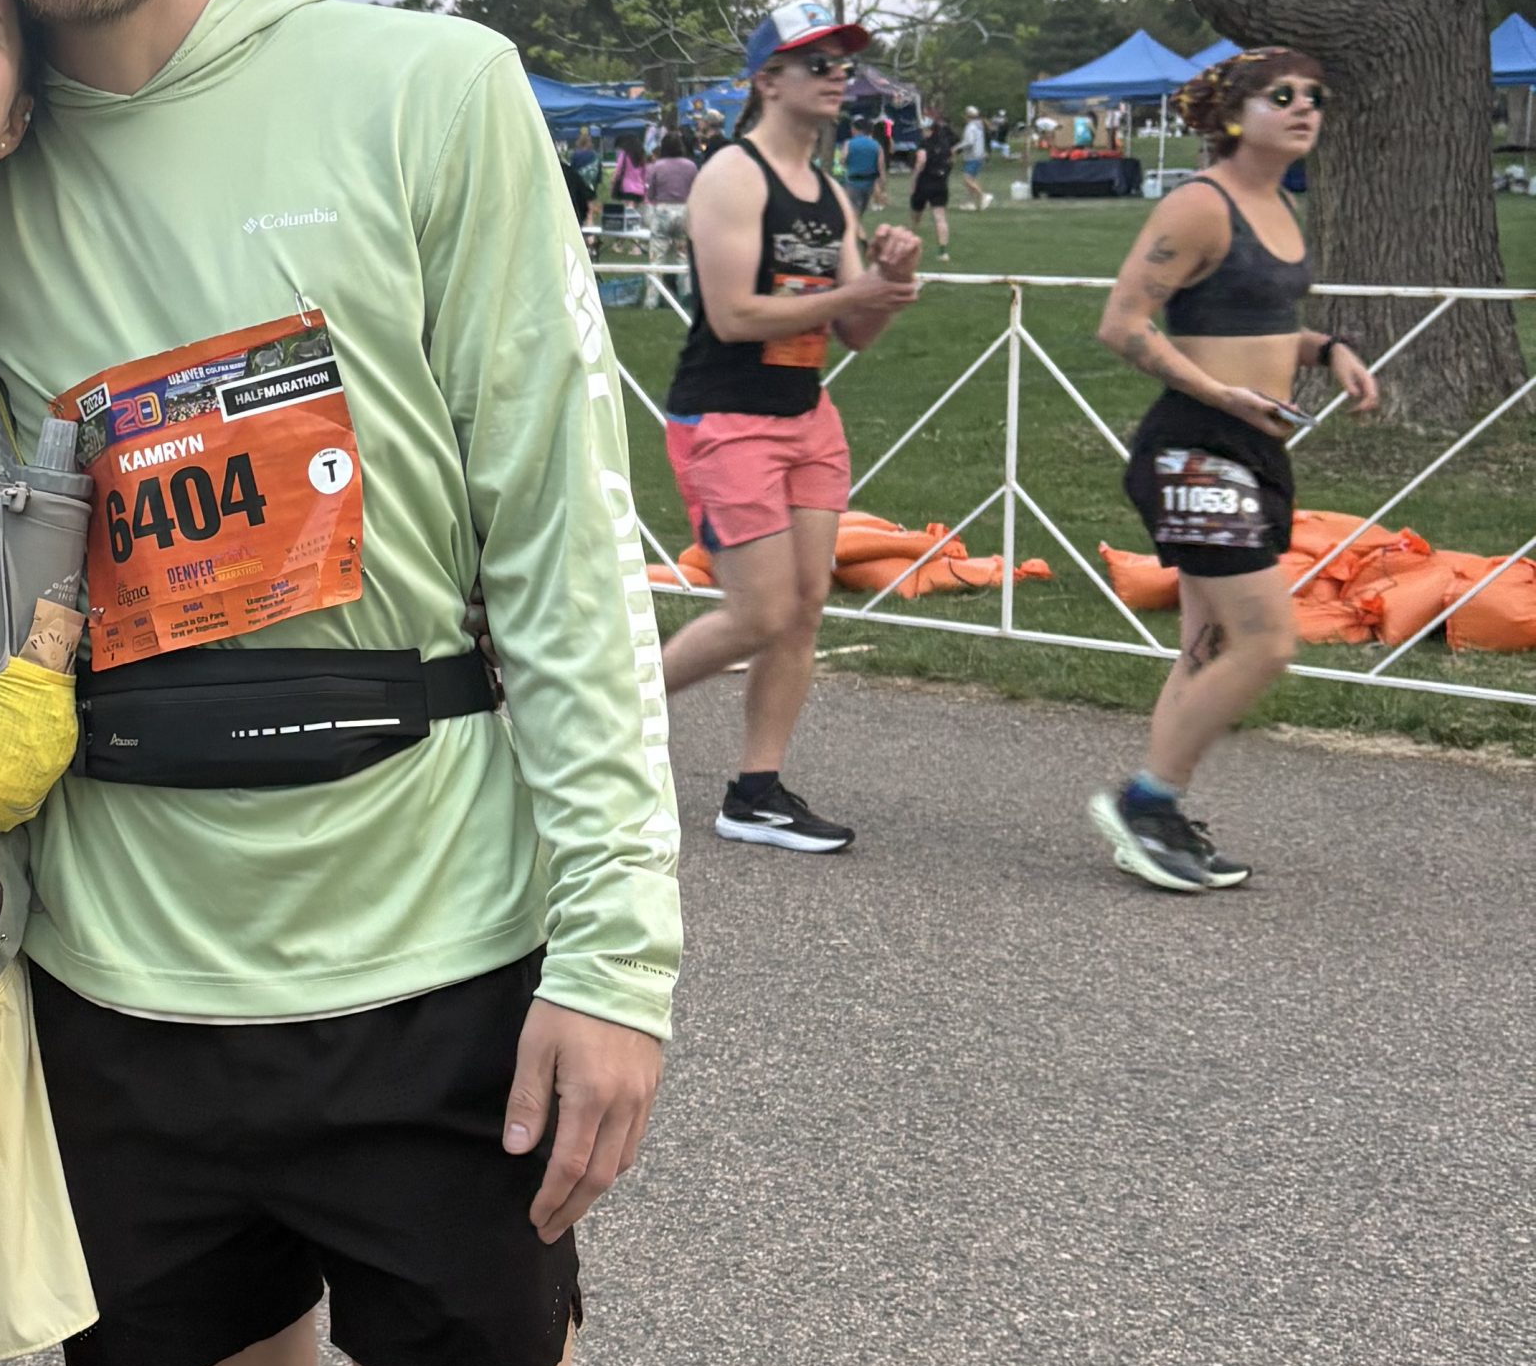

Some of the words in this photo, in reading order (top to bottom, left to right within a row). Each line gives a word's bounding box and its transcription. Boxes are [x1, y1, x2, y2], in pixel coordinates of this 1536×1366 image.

[259, 207, 337, 229] Columbia
[84, 391, 104, 414] 2026
[119, 434, 205, 473] KAMRYN
[323, 459, 337, 482] T
[106, 453, 267, 563] 6404
[167, 559, 214, 585] DENVER
[117, 585, 150, 607] cigna
[171, 577, 216, 593] COLFAX
